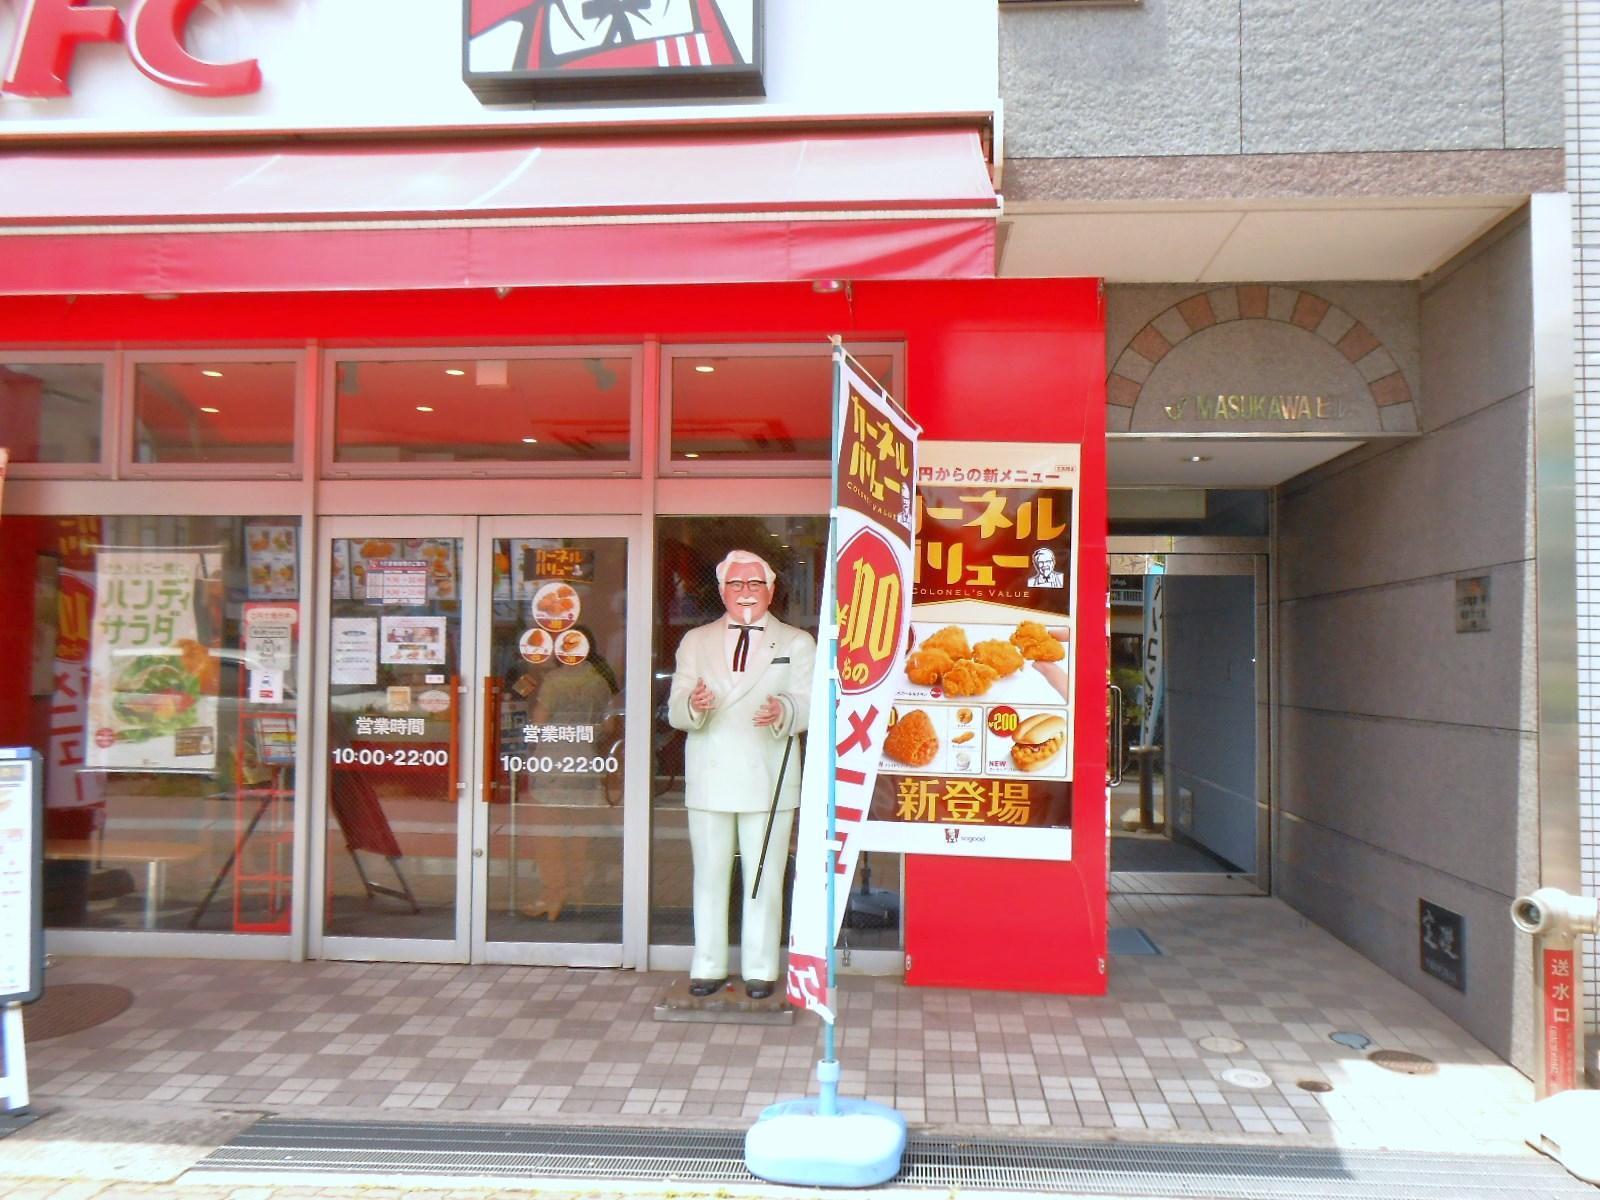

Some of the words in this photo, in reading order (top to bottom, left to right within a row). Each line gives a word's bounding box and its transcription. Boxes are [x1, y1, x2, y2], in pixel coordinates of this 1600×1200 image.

[1197, 395, 1313, 420] MASUKAWA
[851, 396, 909, 477] カーネル
[988, 587, 1030, 598] VALUE
[100, 609, 181, 646] サラダ
[356, 717, 424, 736] 営業時間
[523, 724, 594, 743] 営業時間
[896, 779, 1031, 825] 新登場
[1551, 958, 1570, 1023] 送水口
